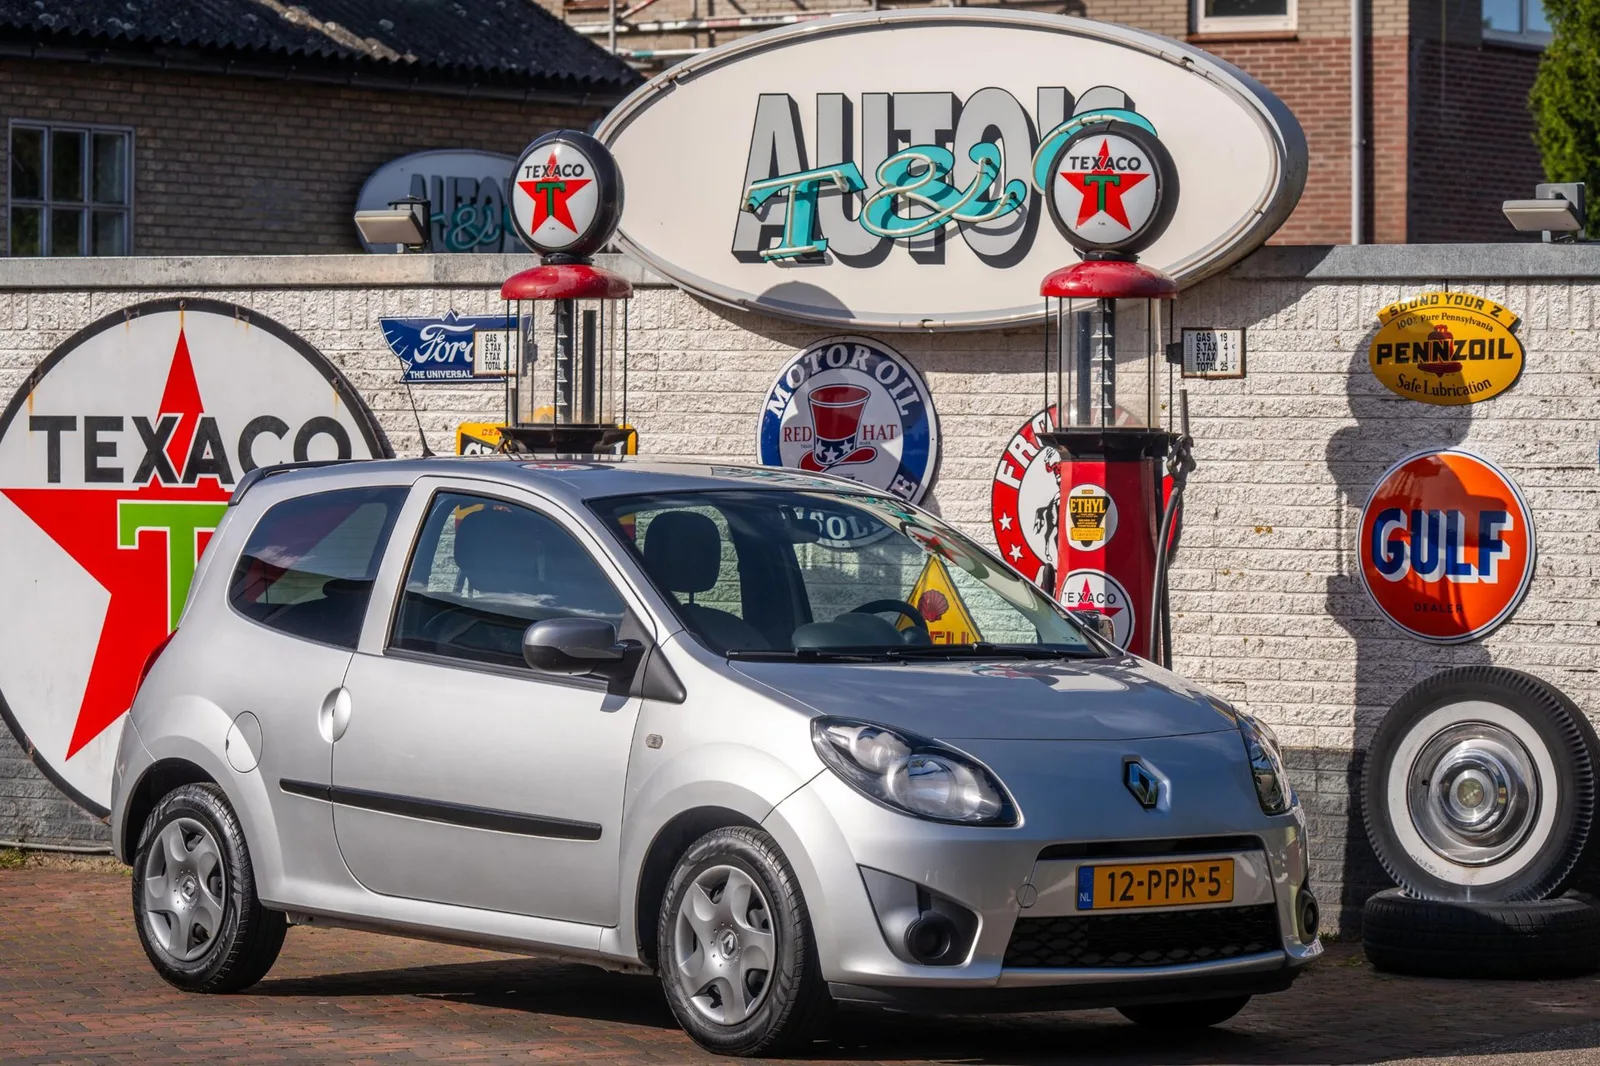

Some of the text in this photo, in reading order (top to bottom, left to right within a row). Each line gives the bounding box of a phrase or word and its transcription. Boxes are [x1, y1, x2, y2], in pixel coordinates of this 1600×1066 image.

[525, 164, 584, 178] TEXACO
[1069, 156, 1141, 171] TEXACO
[731, 86, 1135, 268] AUTO'
[1389, 294, 1503, 318] SOUND YOUR Z
[1420, 313, 1440, 324] Pure
[1441, 312, 1494, 332] Pennsylvania
[485, 333, 497, 342] GAS
[1196, 332, 1211, 342] GAS
[1220, 332, 1228, 342] 19
[485, 343, 502, 352] S.TAX
[1196, 342, 1217, 352] S.TAX
[1223, 342, 1228, 352] 4
[1376, 338, 1514, 365] PENNZOIL
[485, 352, 501, 361] F.TAX
[1196, 352, 1216, 361] F.TAX
[1224, 352, 1228, 361] 1
[485, 361, 502, 370] TOTAL
[1196, 362, 1218, 371] TOTAL
[1220, 362, 1229, 371] 25
[410, 370, 473, 379] THE UNIVERSAL
[767, 344, 920, 419] MOTOR OIL
[1396, 373, 1492, 397] Safe Lubrication
[783, 426, 812, 442] RED
[862, 424, 897, 441] HAT
[29, 415, 353, 485] TEXACO
[1070, 498, 1106, 513] ETHYL
[1371, 508, 1514, 584] GULF
[1414, 603, 1464, 613] DEALER
[1080, 866, 1221, 902] NL 12-PPR-5
